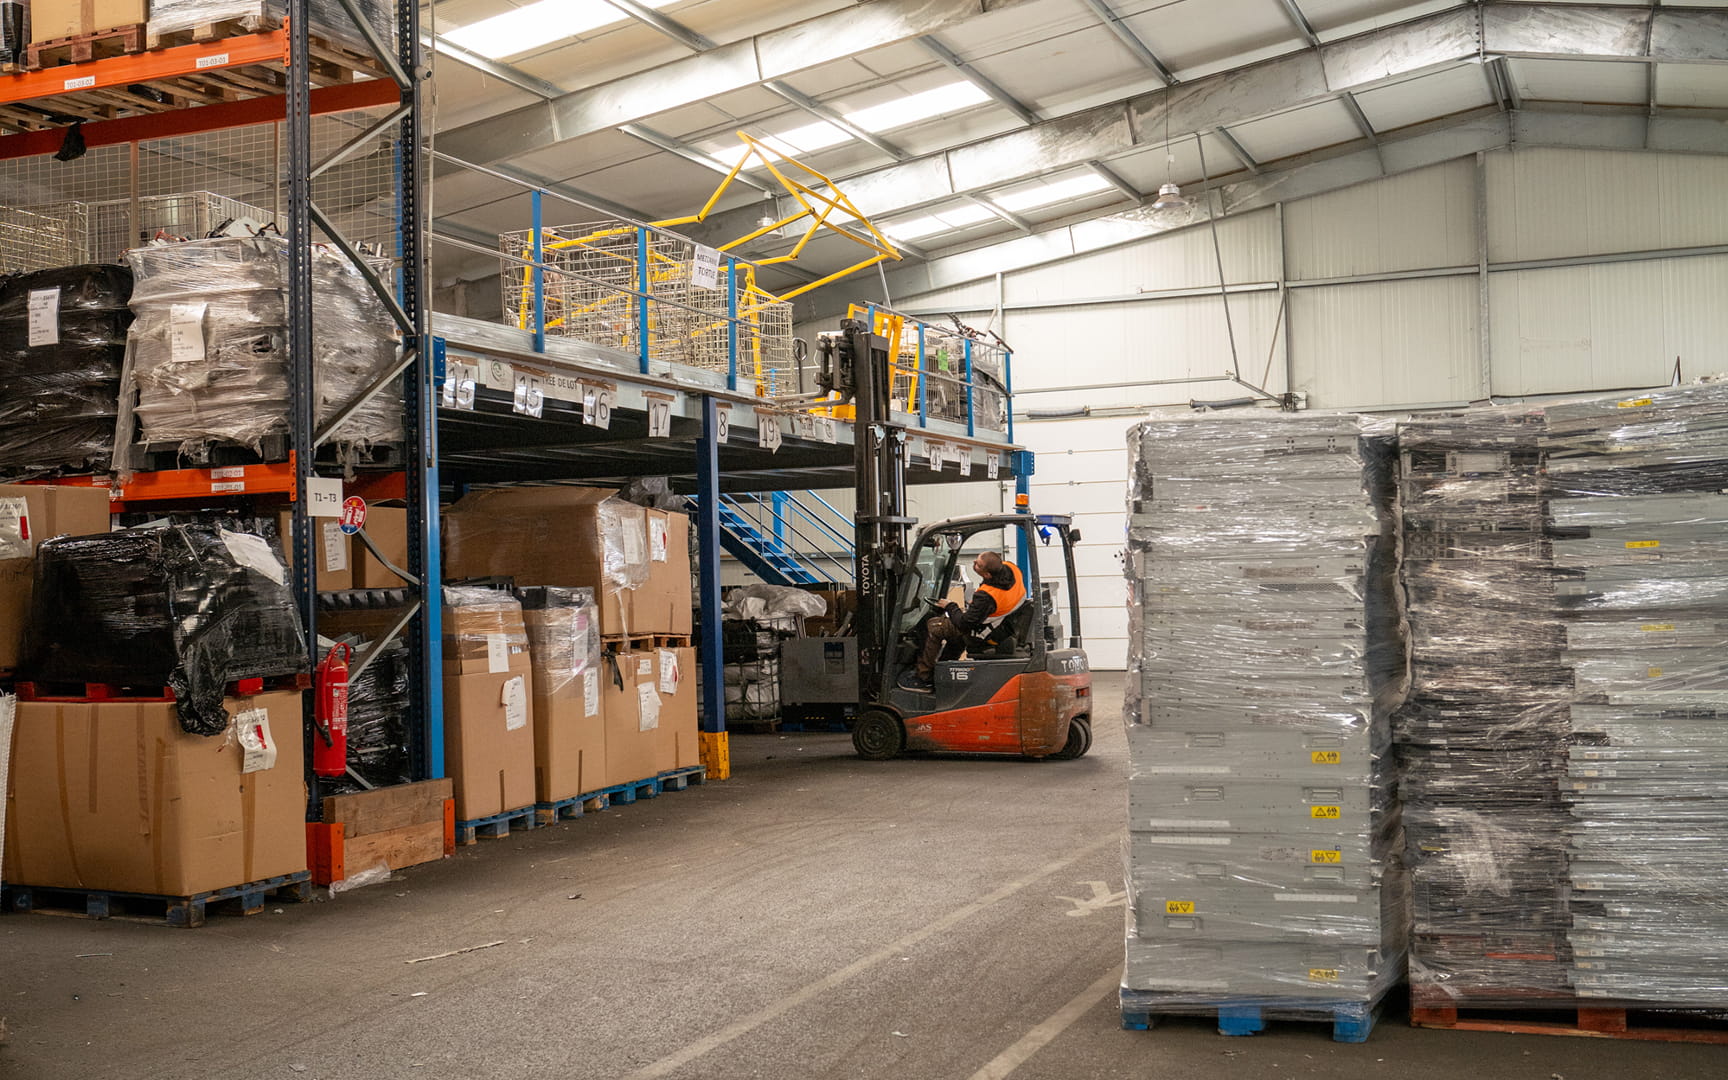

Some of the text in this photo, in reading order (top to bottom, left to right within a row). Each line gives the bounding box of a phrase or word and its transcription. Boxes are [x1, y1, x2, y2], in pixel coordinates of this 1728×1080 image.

[519, 375, 541, 408] 15
[557, 378, 567, 388] DE
[587, 389, 609, 421] 16
[651, 403, 669, 433] 17
[760, 416, 775, 443] 19
[314, 492, 337, 503] T1-T3
[861, 554, 870, 596] TOYOTA
[950, 672, 969, 681] 16
